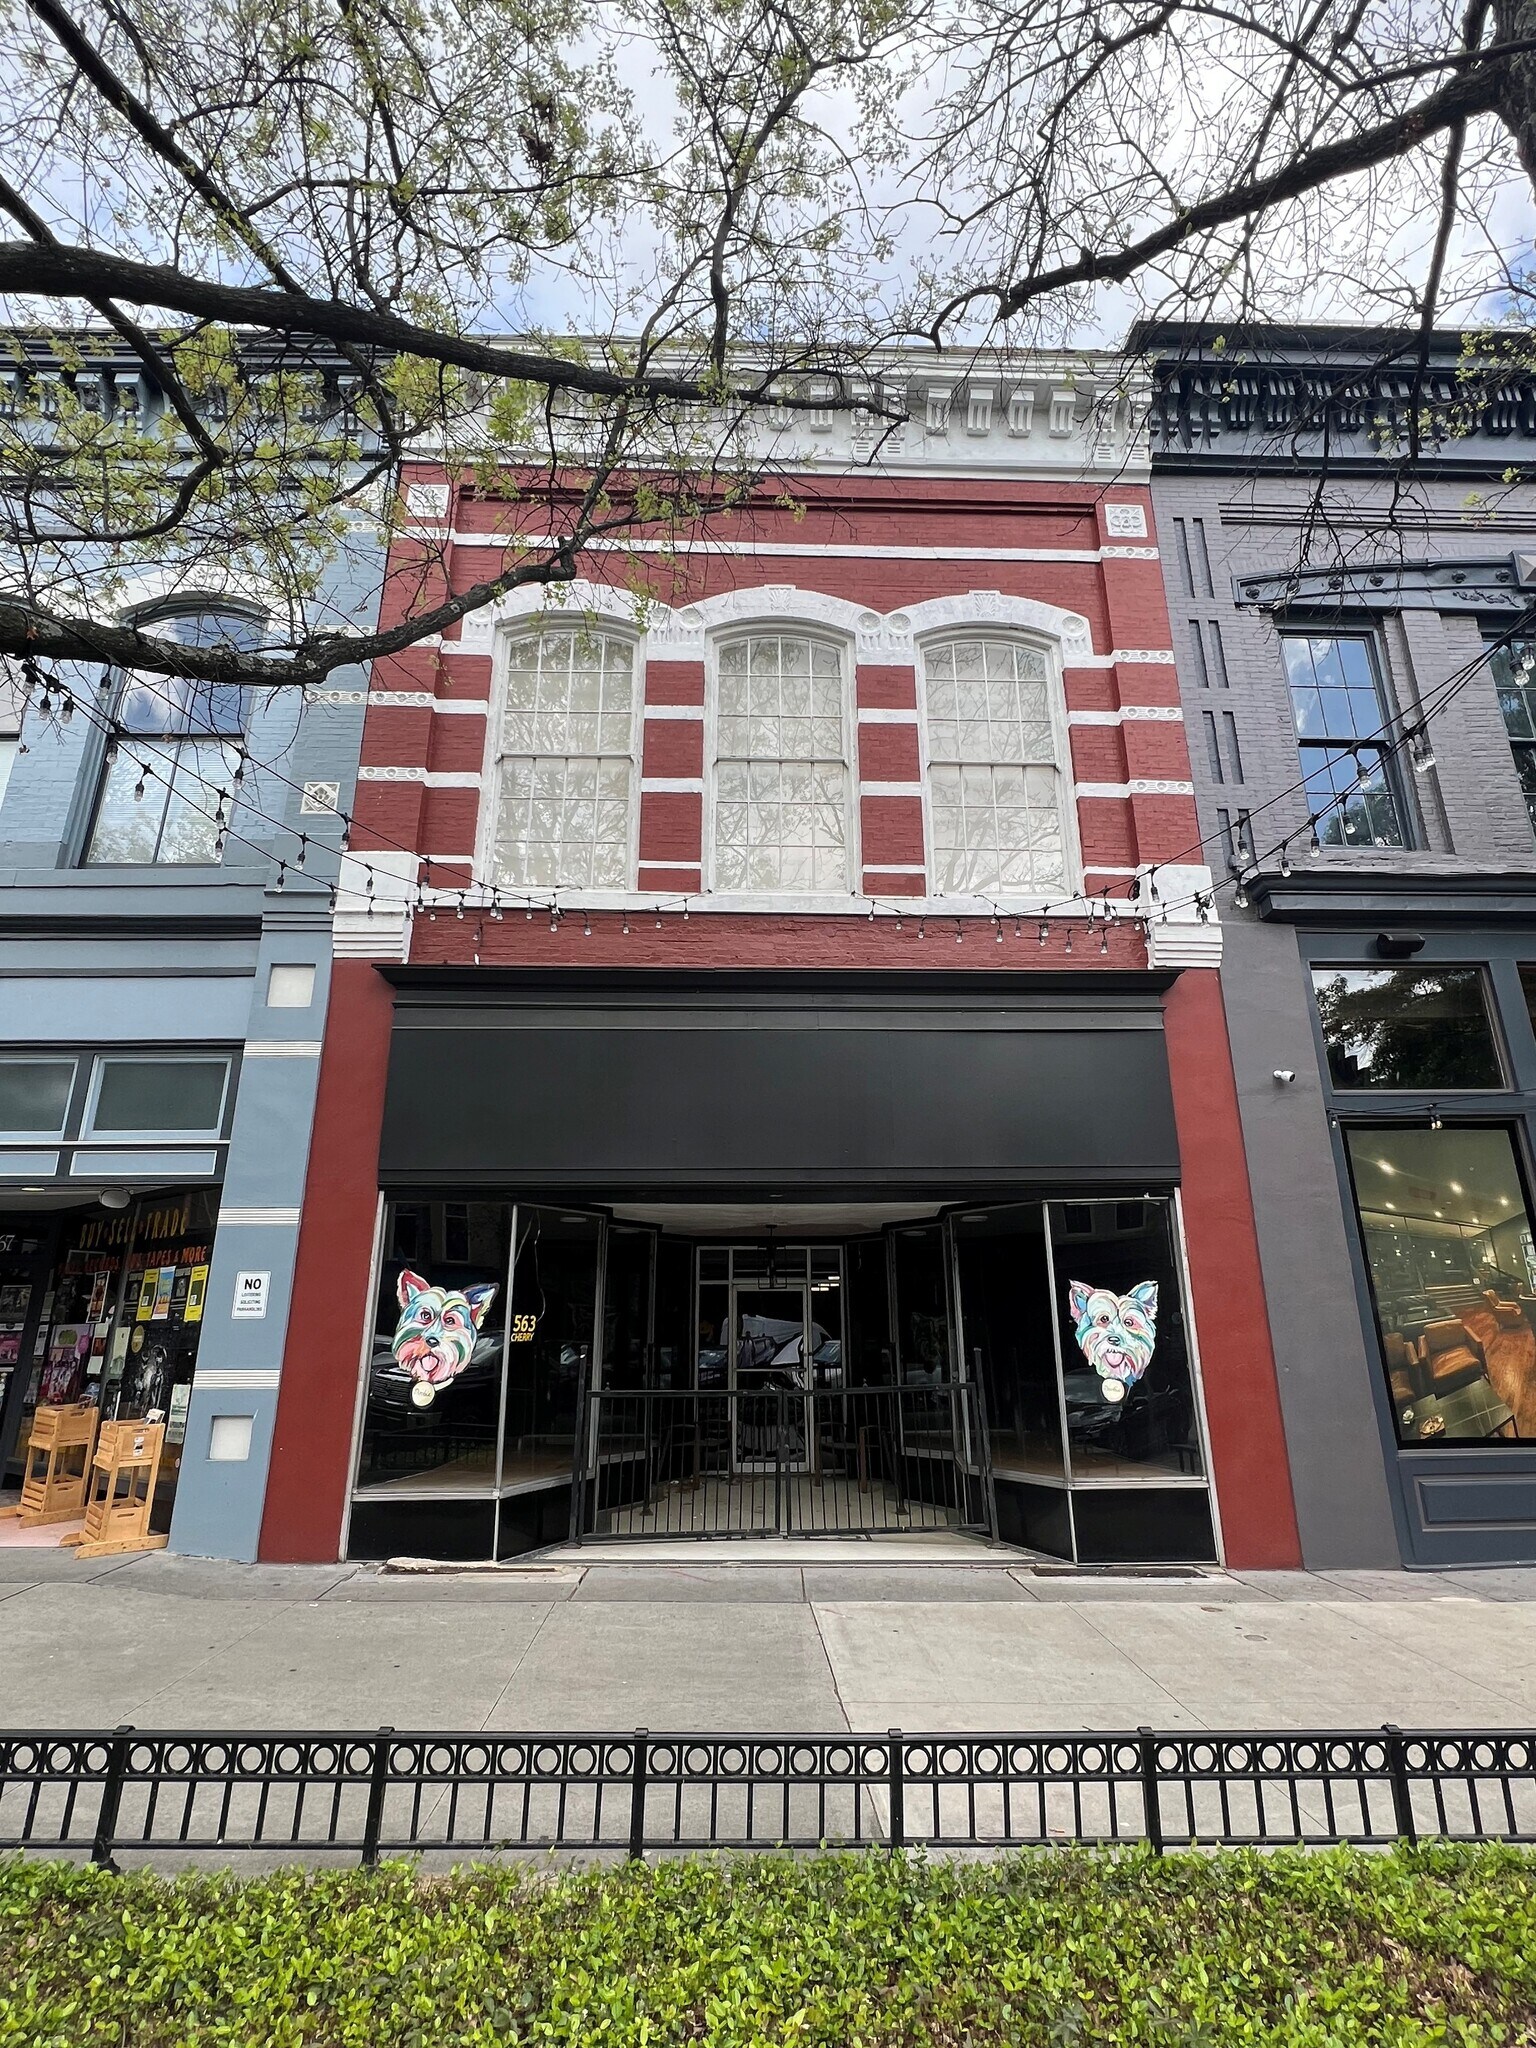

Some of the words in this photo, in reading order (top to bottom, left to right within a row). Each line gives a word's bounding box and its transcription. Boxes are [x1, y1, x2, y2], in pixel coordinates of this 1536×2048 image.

[79, 1219, 104, 1249] BUY
[144, 1207, 189, 1240] TRADE
[181, 1245, 208, 1264] MORE
[244, 1278, 262, 1290] NO
[512, 1314, 537, 1332] 563
[510, 1332, 535, 1342] CHERRY
